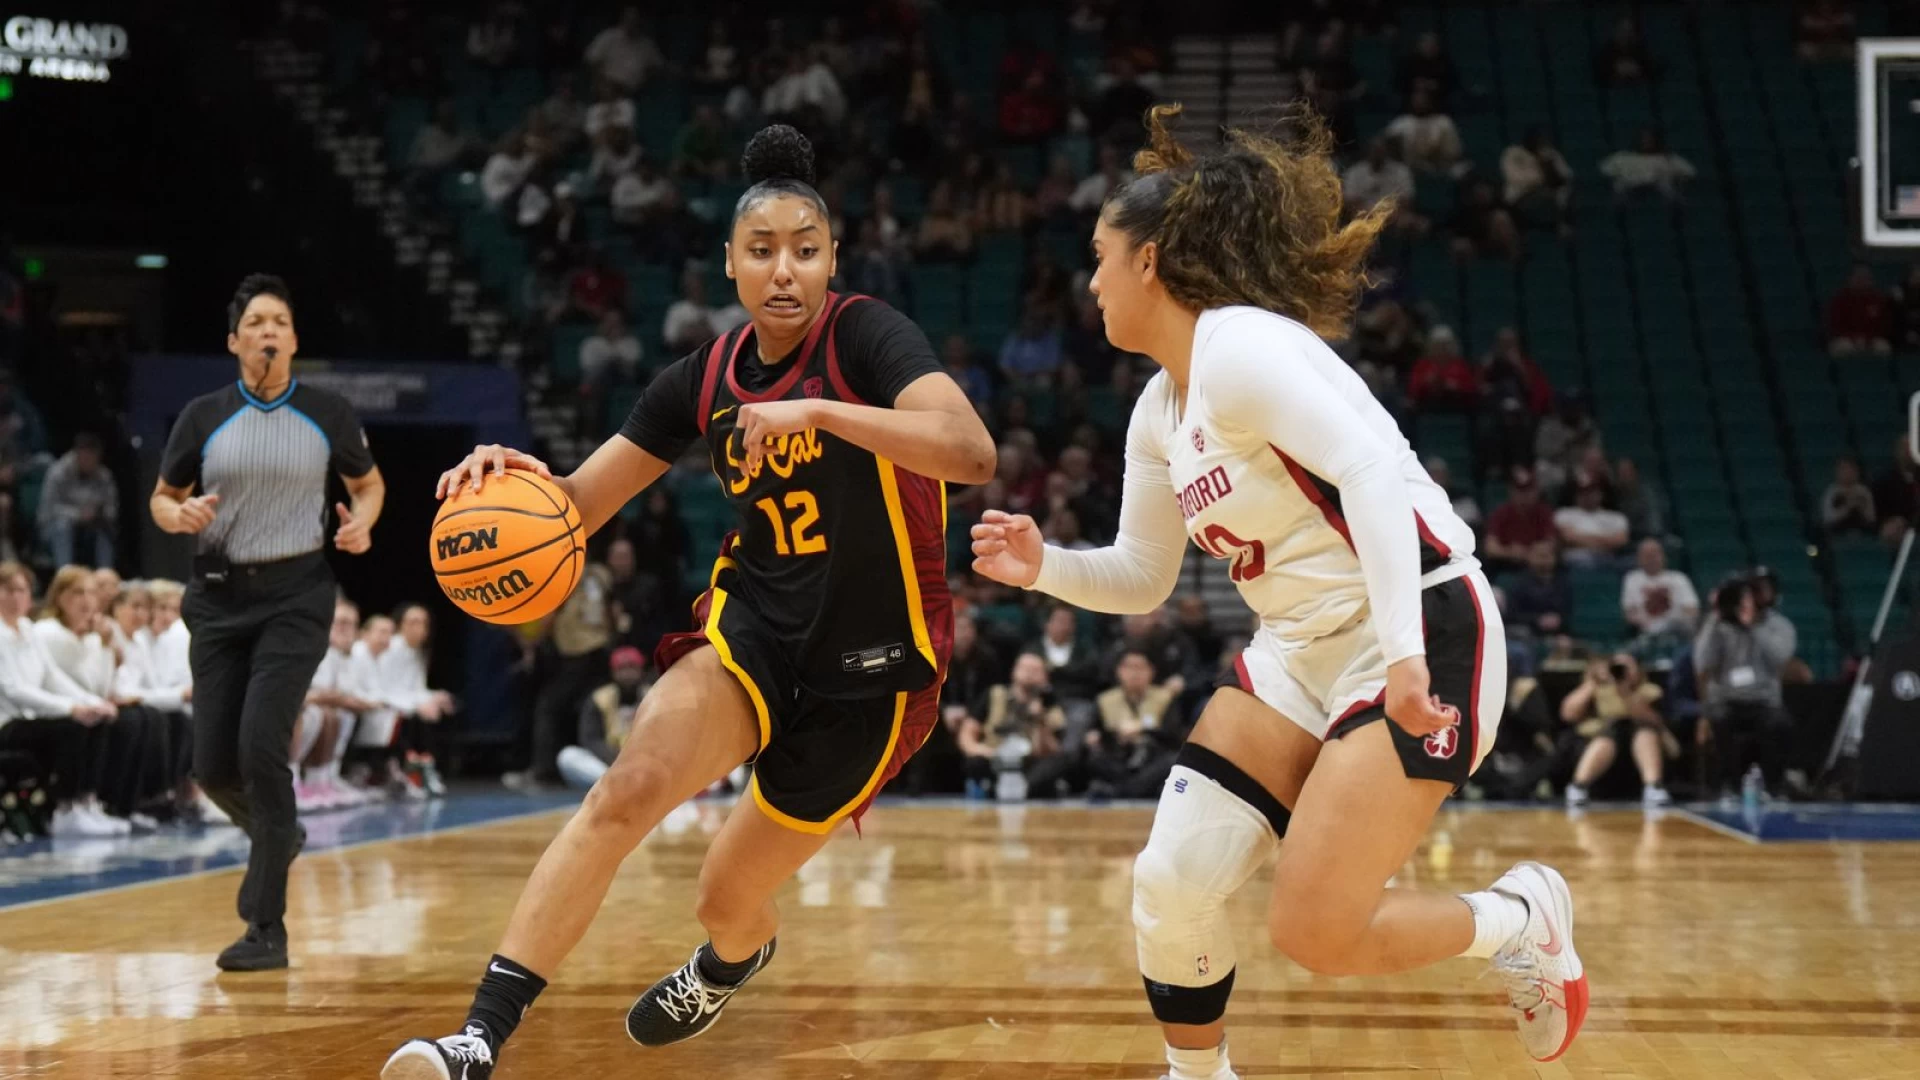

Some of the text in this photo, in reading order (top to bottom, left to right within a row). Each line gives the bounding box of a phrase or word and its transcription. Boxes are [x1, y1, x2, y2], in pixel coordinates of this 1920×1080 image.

[4, 15, 128, 59] GRAND
[756, 490, 827, 555] 12
[437, 527, 498, 561] NCAA
[442, 569, 533, 606] Wilson
